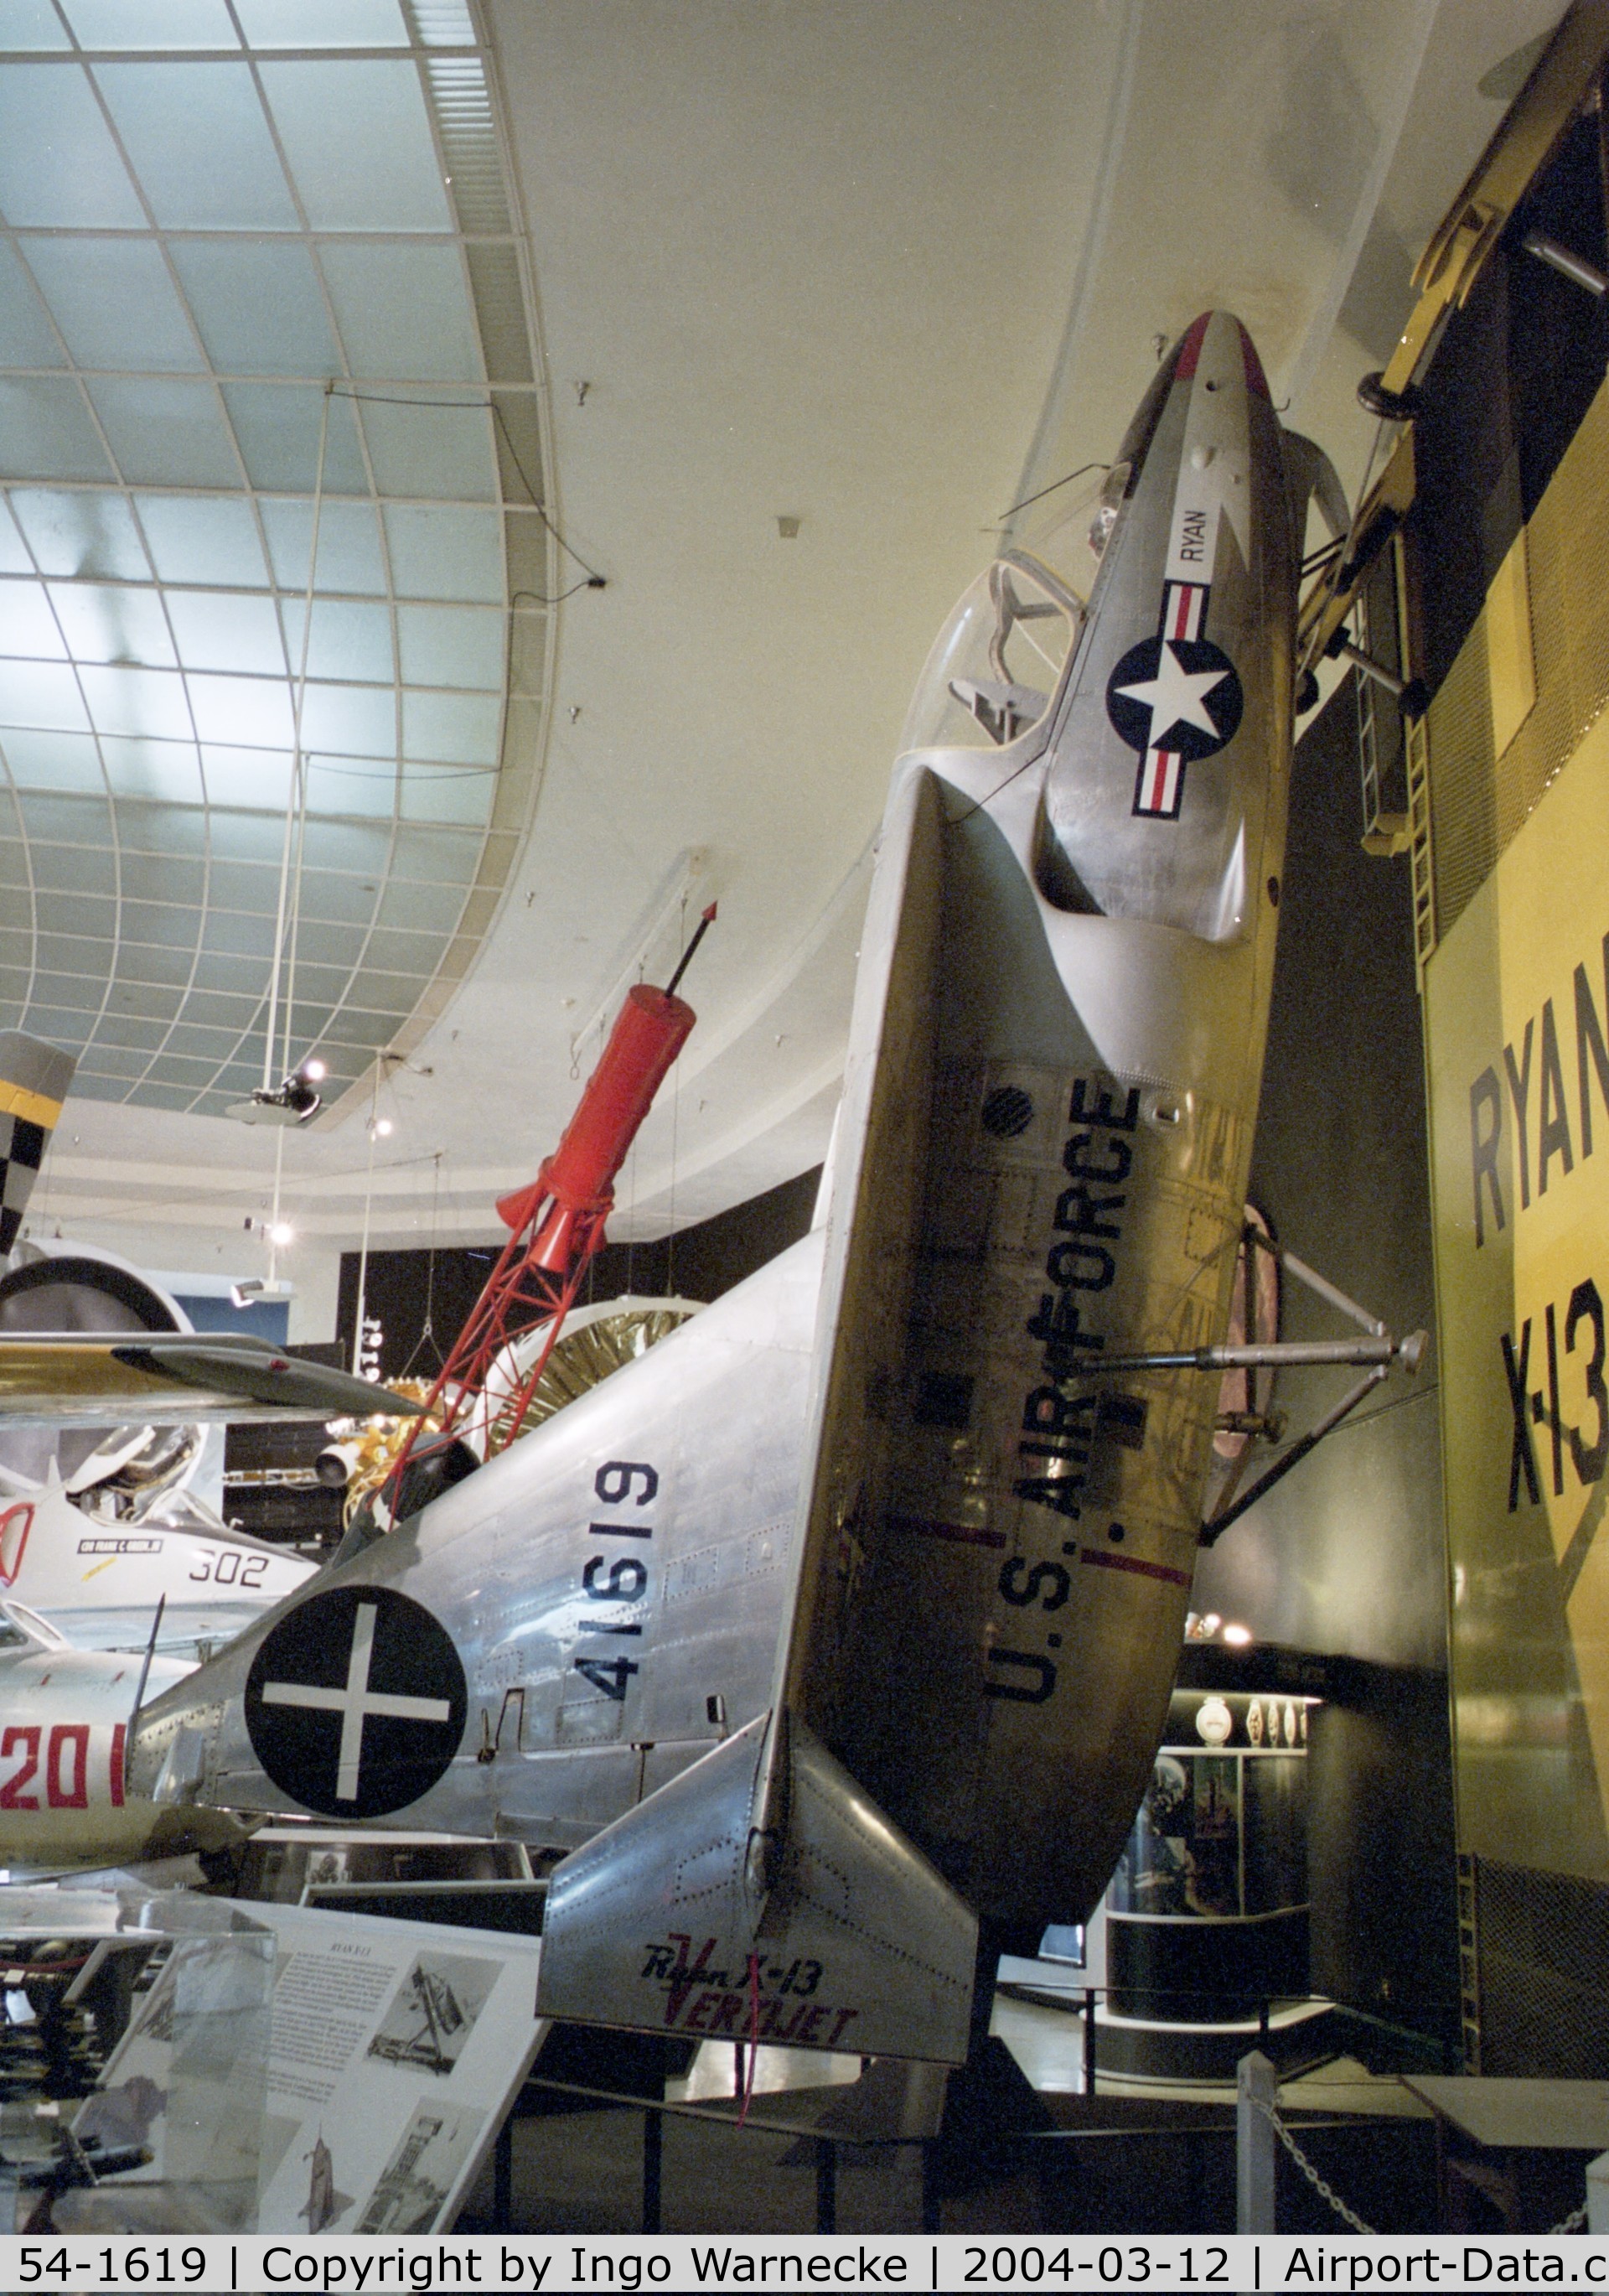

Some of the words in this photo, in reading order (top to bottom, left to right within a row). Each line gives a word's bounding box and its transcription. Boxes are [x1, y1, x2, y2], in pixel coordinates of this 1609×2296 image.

[1181, 511, 1207, 562] RYAN
[1470, 930, 1609, 1250] RYAN
[1037, 1078, 1141, 1350] FORCE
[1012, 1385, 1097, 1521] AIR
[1500, 1277, 1609, 1513] X-13
[189, 1548, 269, 1588] 302
[574, 1460, 659, 1701] 41619
[983, 1542, 1076, 1704] U.S.
[0, 1723, 127, 1811] 201
[736, 1953, 824, 1997] X-13
